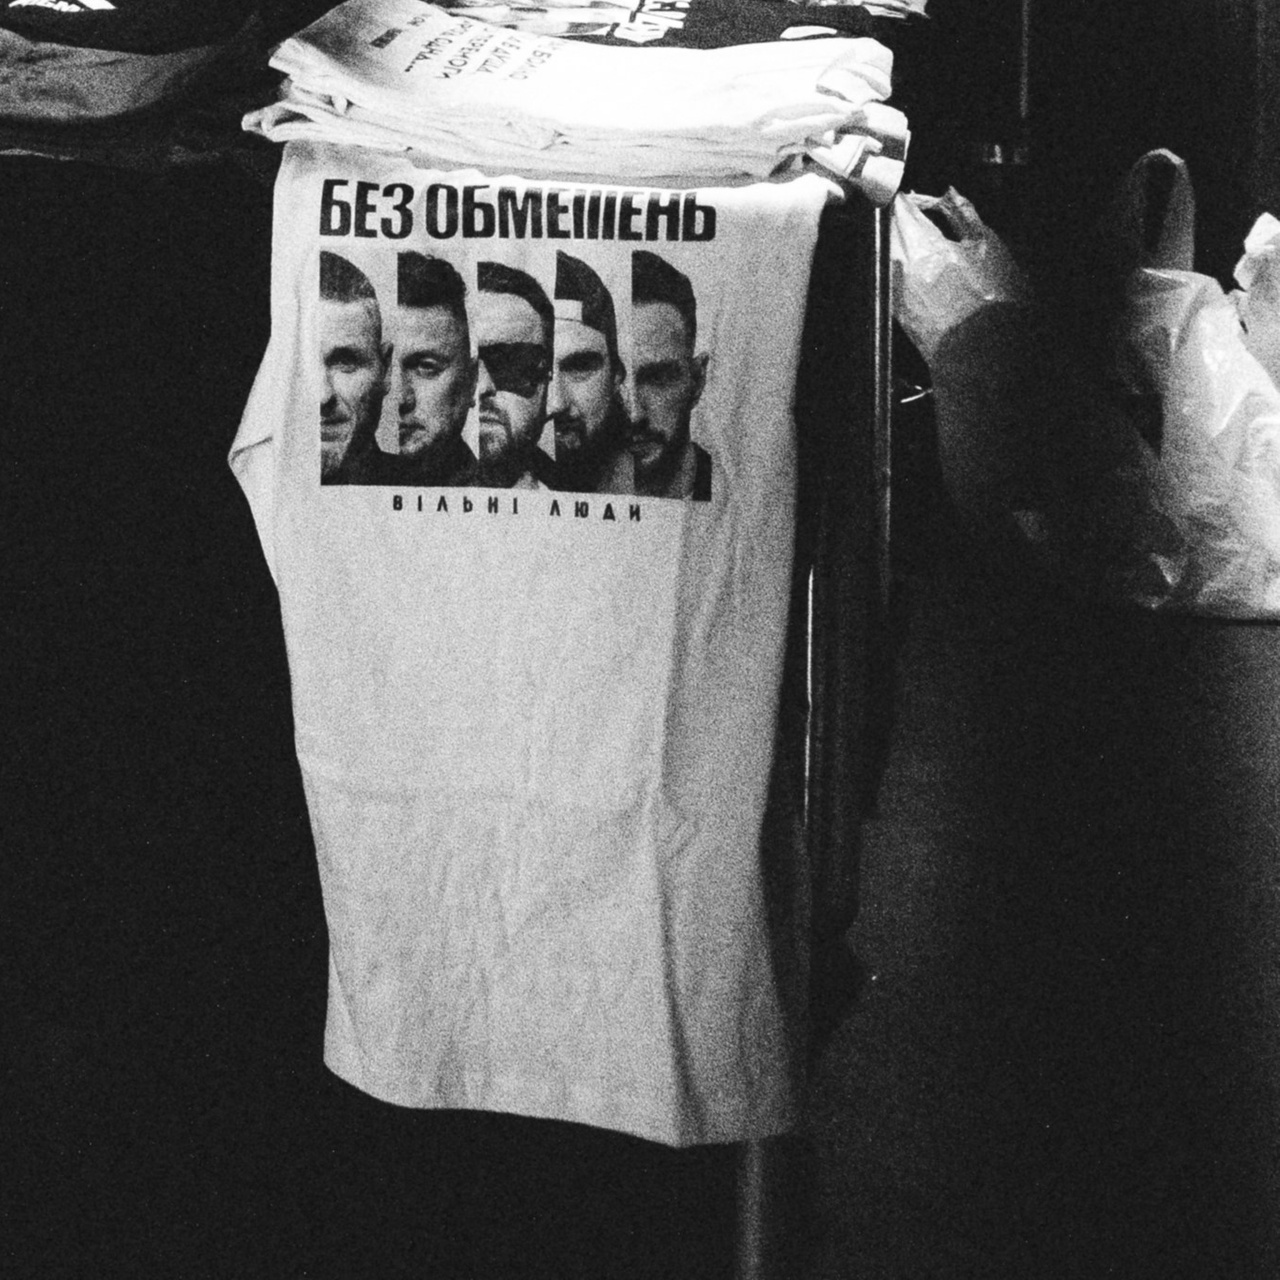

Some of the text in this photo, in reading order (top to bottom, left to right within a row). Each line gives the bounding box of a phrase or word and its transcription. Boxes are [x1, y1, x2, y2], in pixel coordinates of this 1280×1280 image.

[320, 178, 415, 239] БЕЗ
[393, 495, 641, 523] ВІЛЬНІ ЛЮДИ
